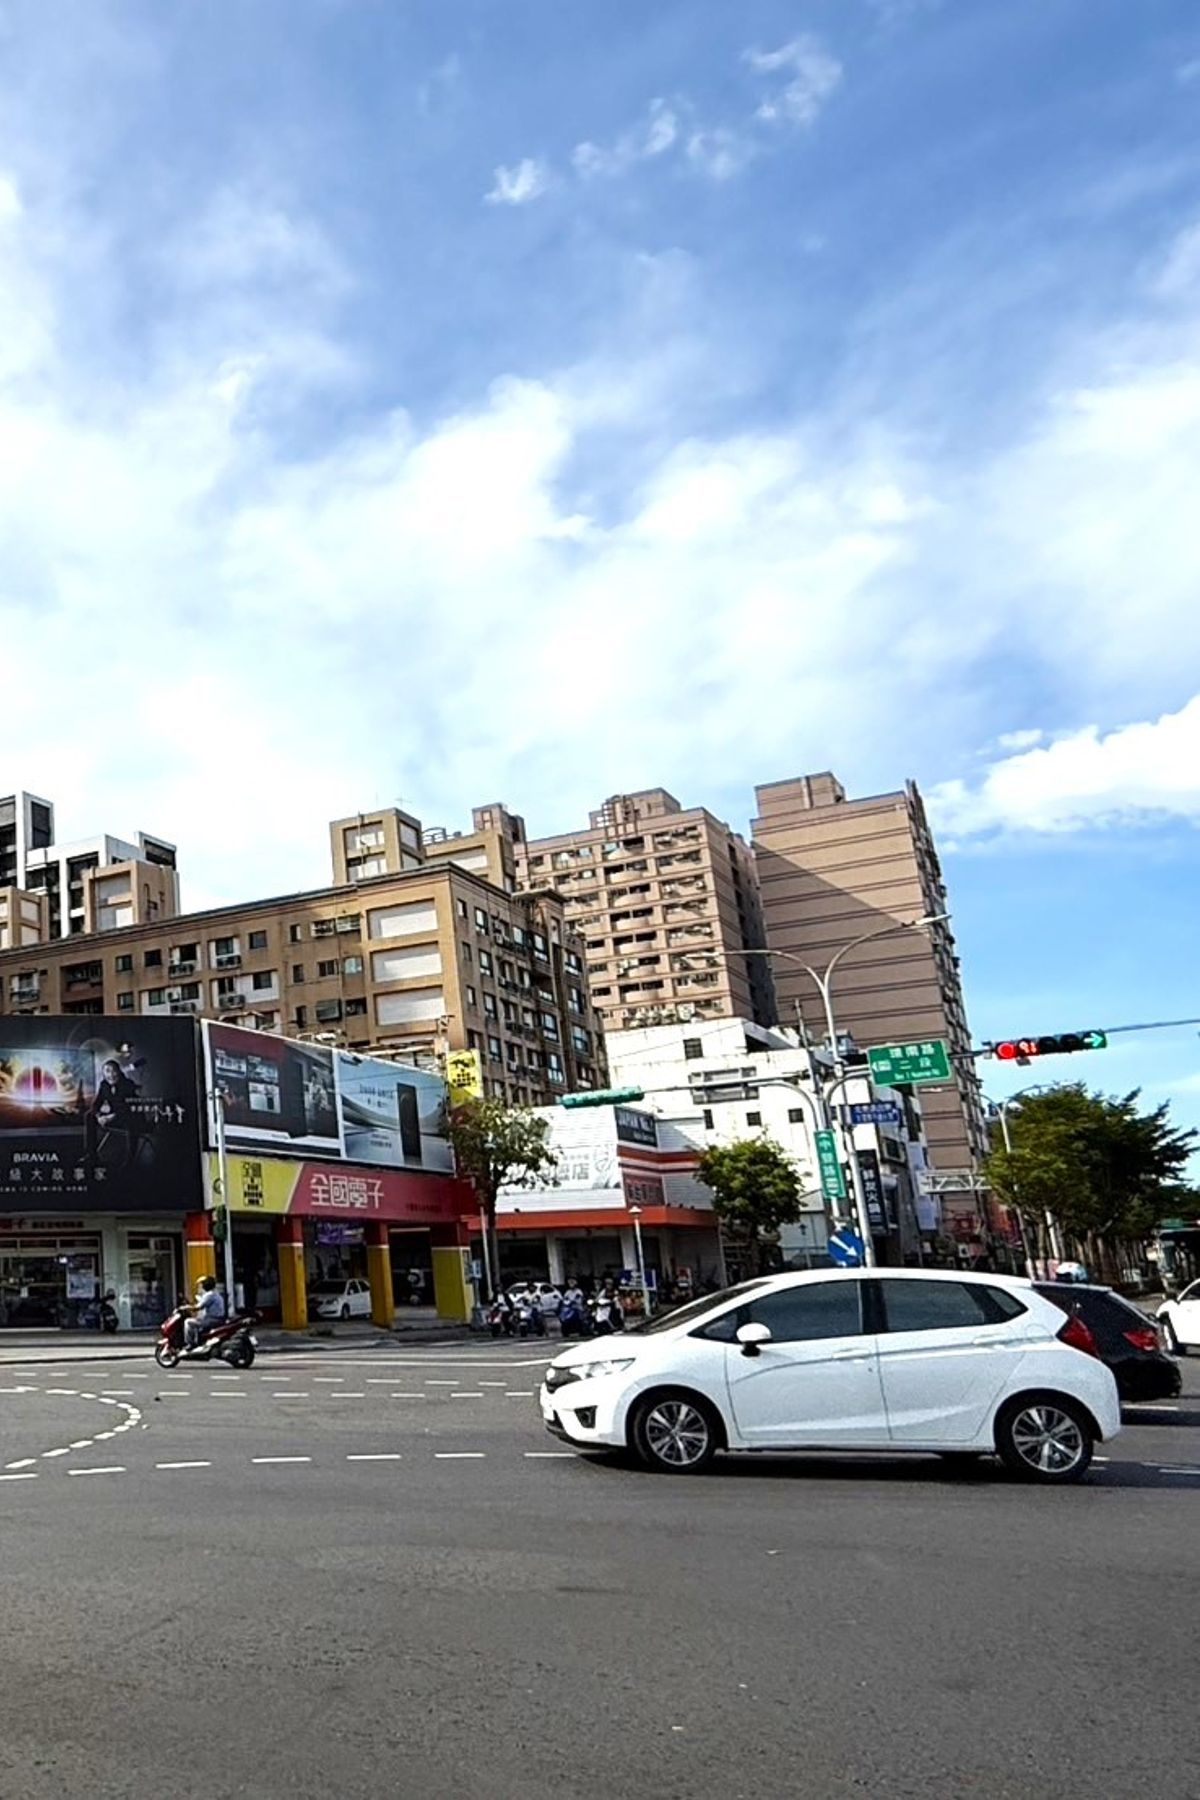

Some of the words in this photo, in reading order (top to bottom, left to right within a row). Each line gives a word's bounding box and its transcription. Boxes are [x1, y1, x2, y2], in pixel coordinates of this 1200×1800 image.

[13, 1152, 61, 1163] BRAVIA
[310, 1172, 385, 1210] 全國電子
